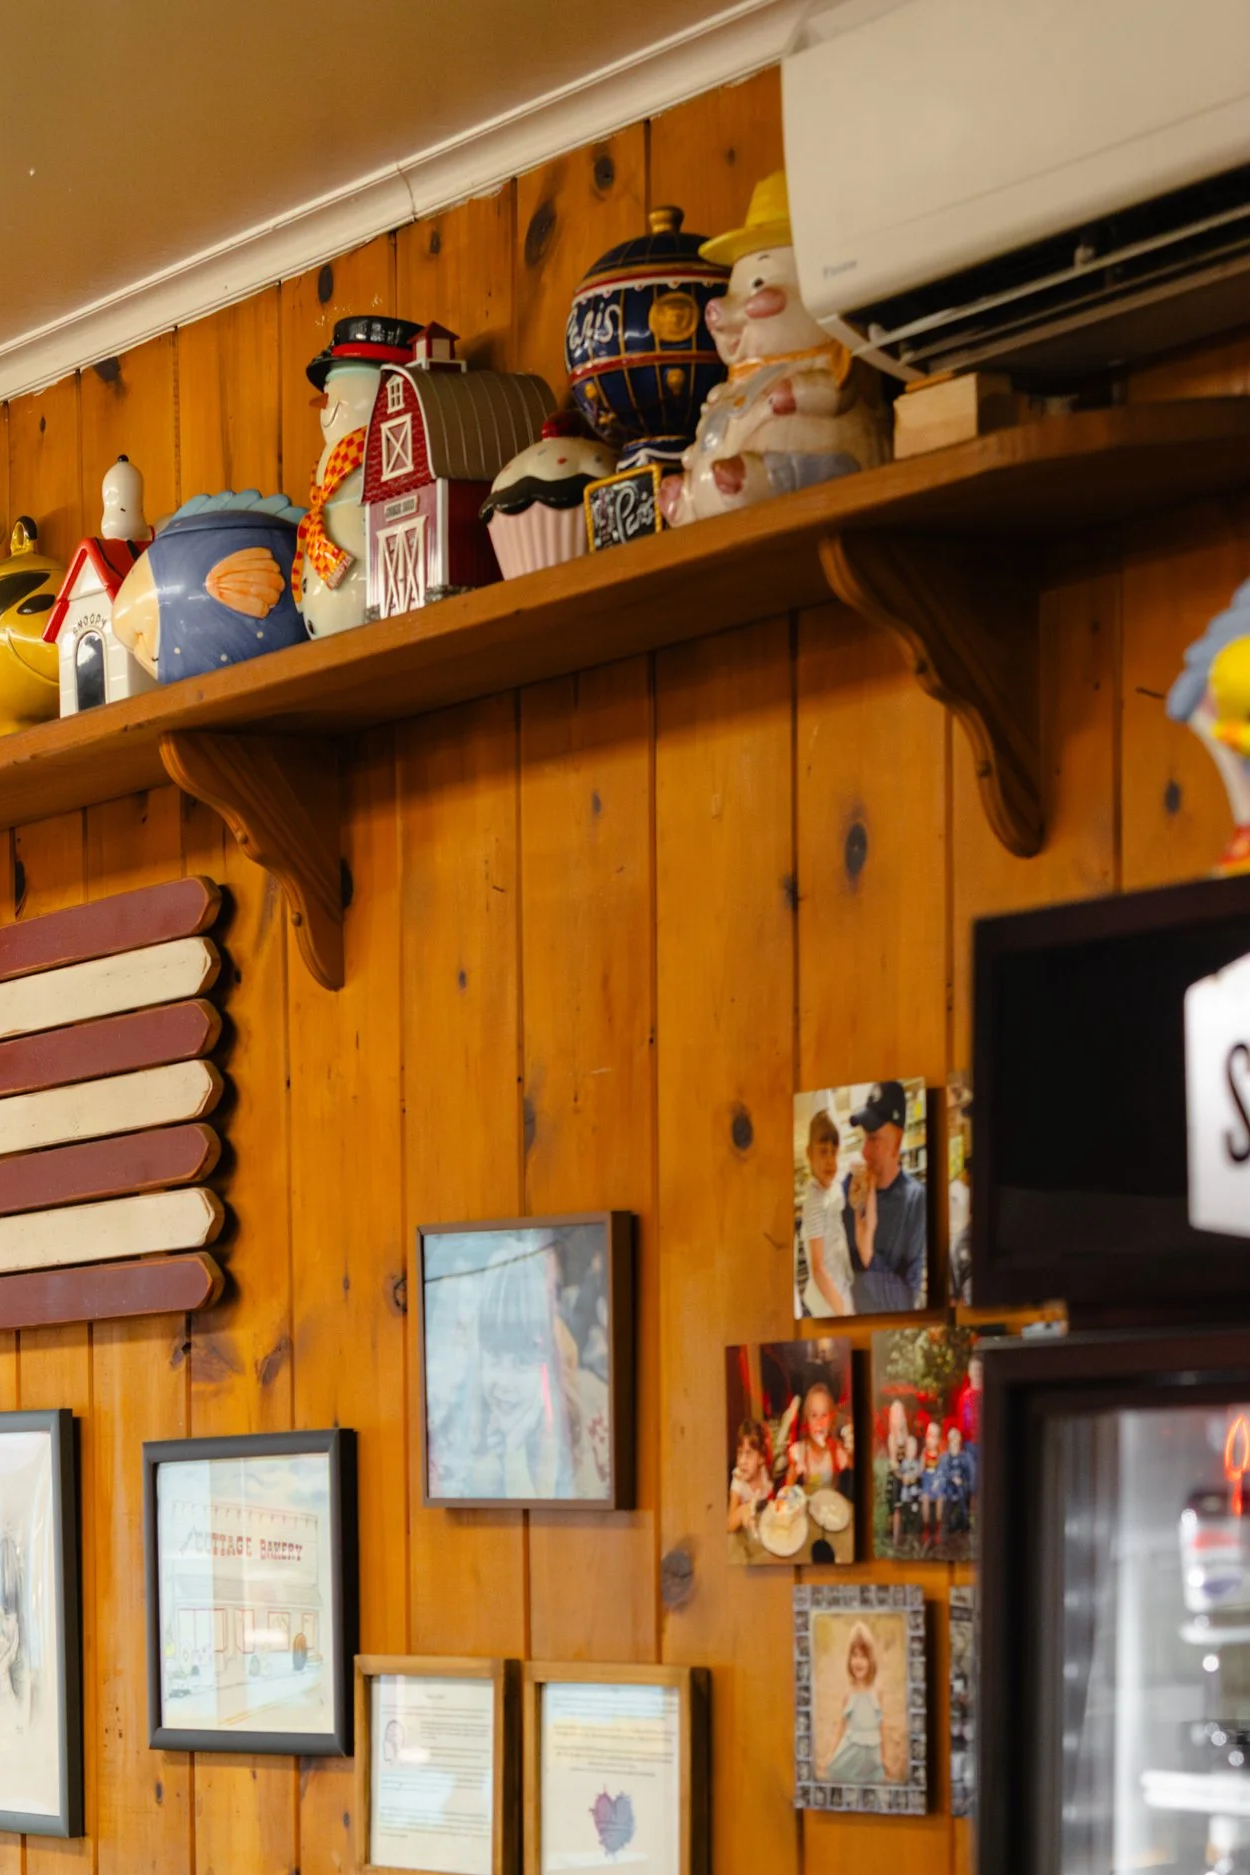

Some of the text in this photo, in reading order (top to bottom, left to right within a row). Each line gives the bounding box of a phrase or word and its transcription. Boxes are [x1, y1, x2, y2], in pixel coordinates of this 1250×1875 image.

[72, 612, 107, 636] SNOOPY
[195, 1531, 303, 1561] COTTAGE BAKERY
